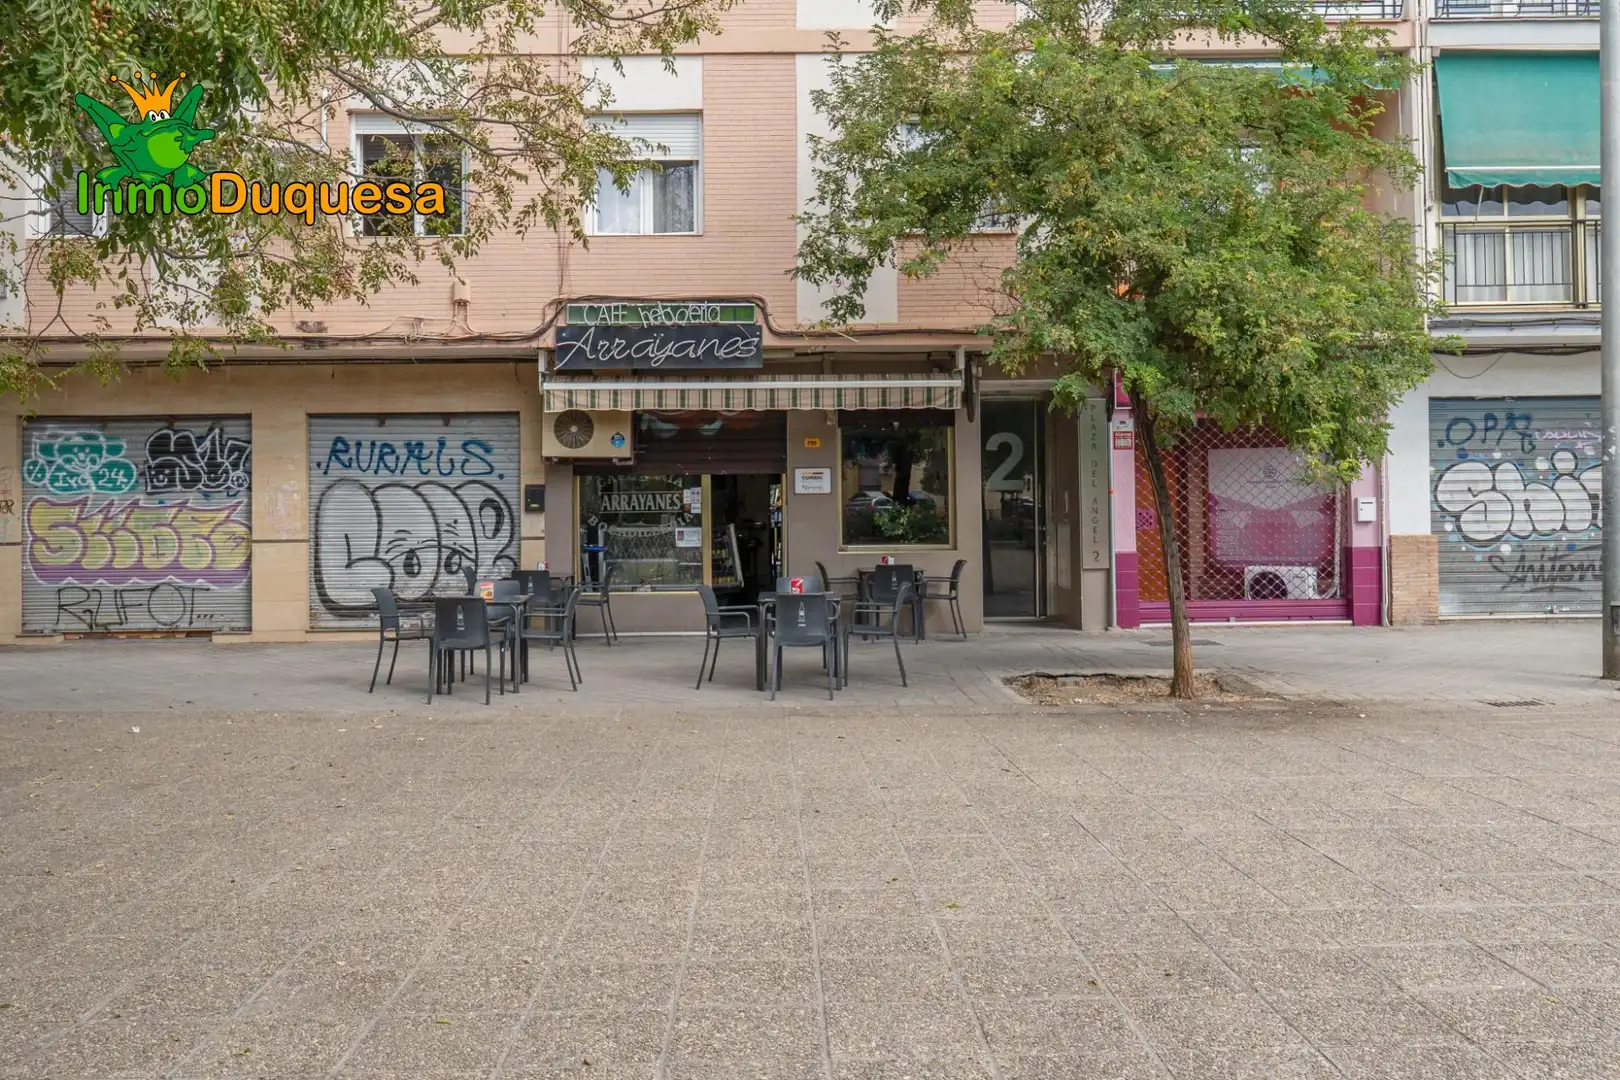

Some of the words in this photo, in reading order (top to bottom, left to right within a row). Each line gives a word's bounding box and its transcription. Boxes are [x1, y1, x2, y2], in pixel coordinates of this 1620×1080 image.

[985, 432, 1024, 491] 2
[600, 493, 681, 511] ARRAYANES
[1092, 551, 1100, 563] 2
